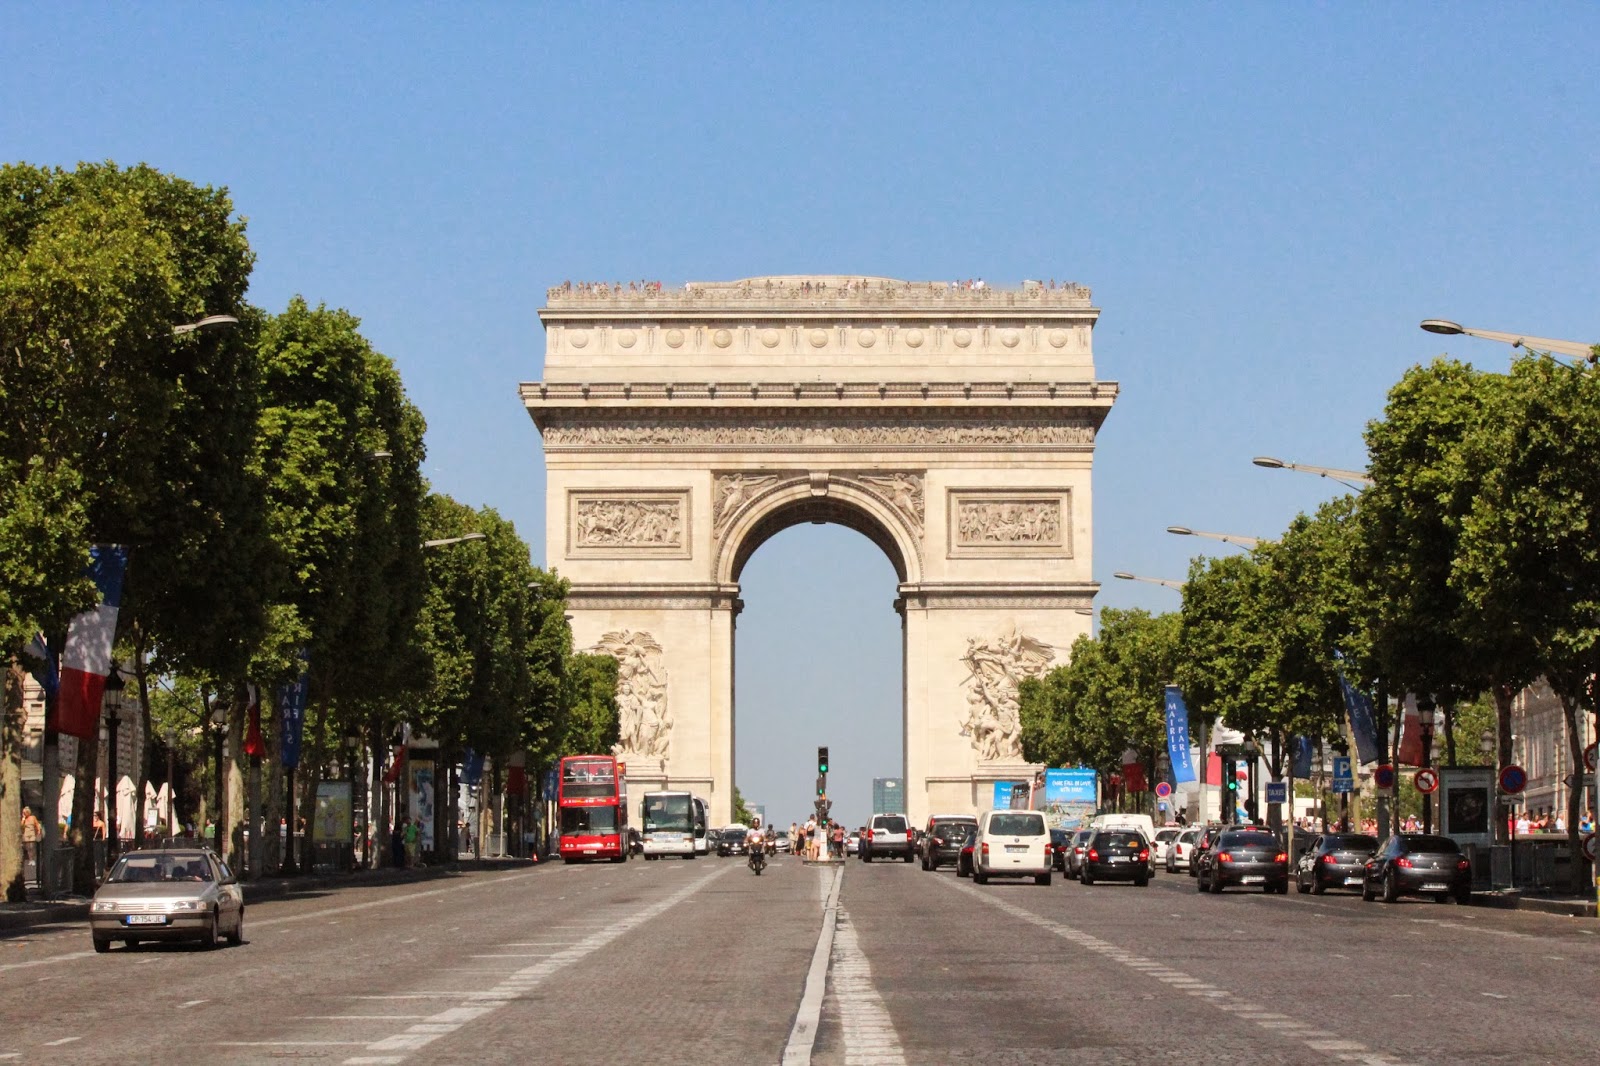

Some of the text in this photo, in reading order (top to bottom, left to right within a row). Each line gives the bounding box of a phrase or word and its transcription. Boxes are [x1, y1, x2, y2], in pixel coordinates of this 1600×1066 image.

[1167, 702, 1177, 752] MAIRIE
[1178, 726, 1188, 769] PARIS
[1339, 761, 1350, 776] P
